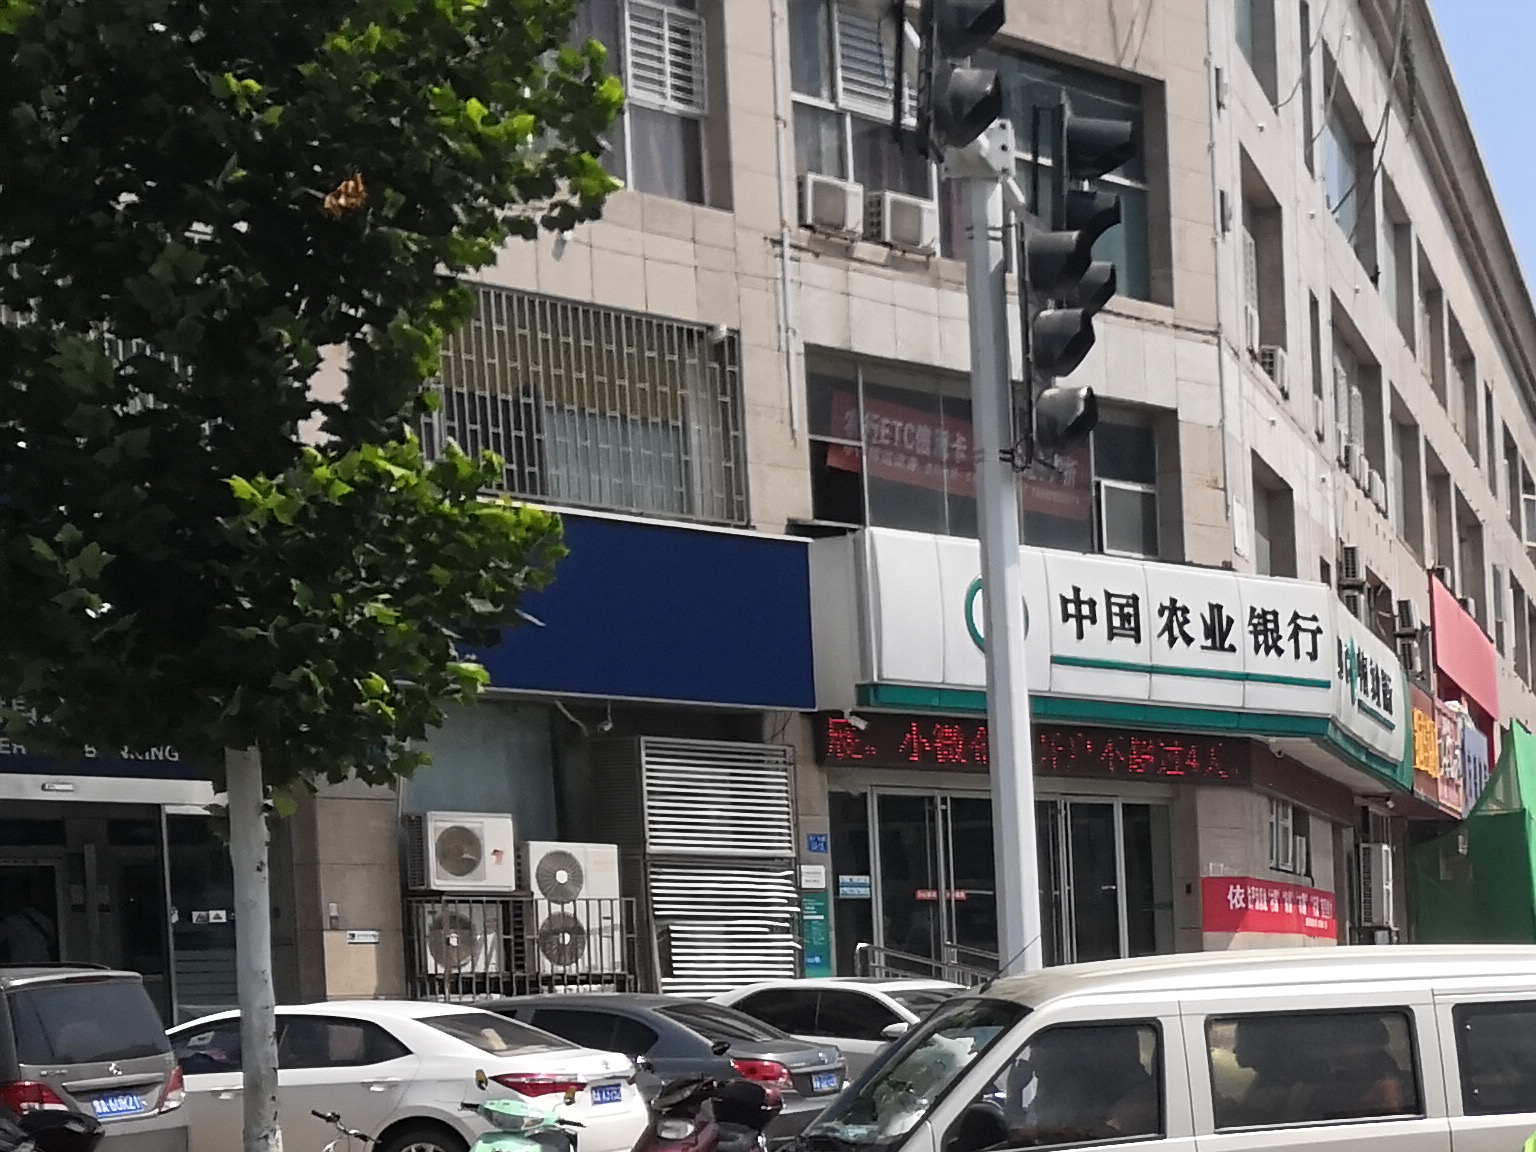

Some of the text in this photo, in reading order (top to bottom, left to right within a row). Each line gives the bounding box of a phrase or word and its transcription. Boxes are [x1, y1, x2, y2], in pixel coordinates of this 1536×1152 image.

[1059, 584, 1324, 662] 中国农业银行
